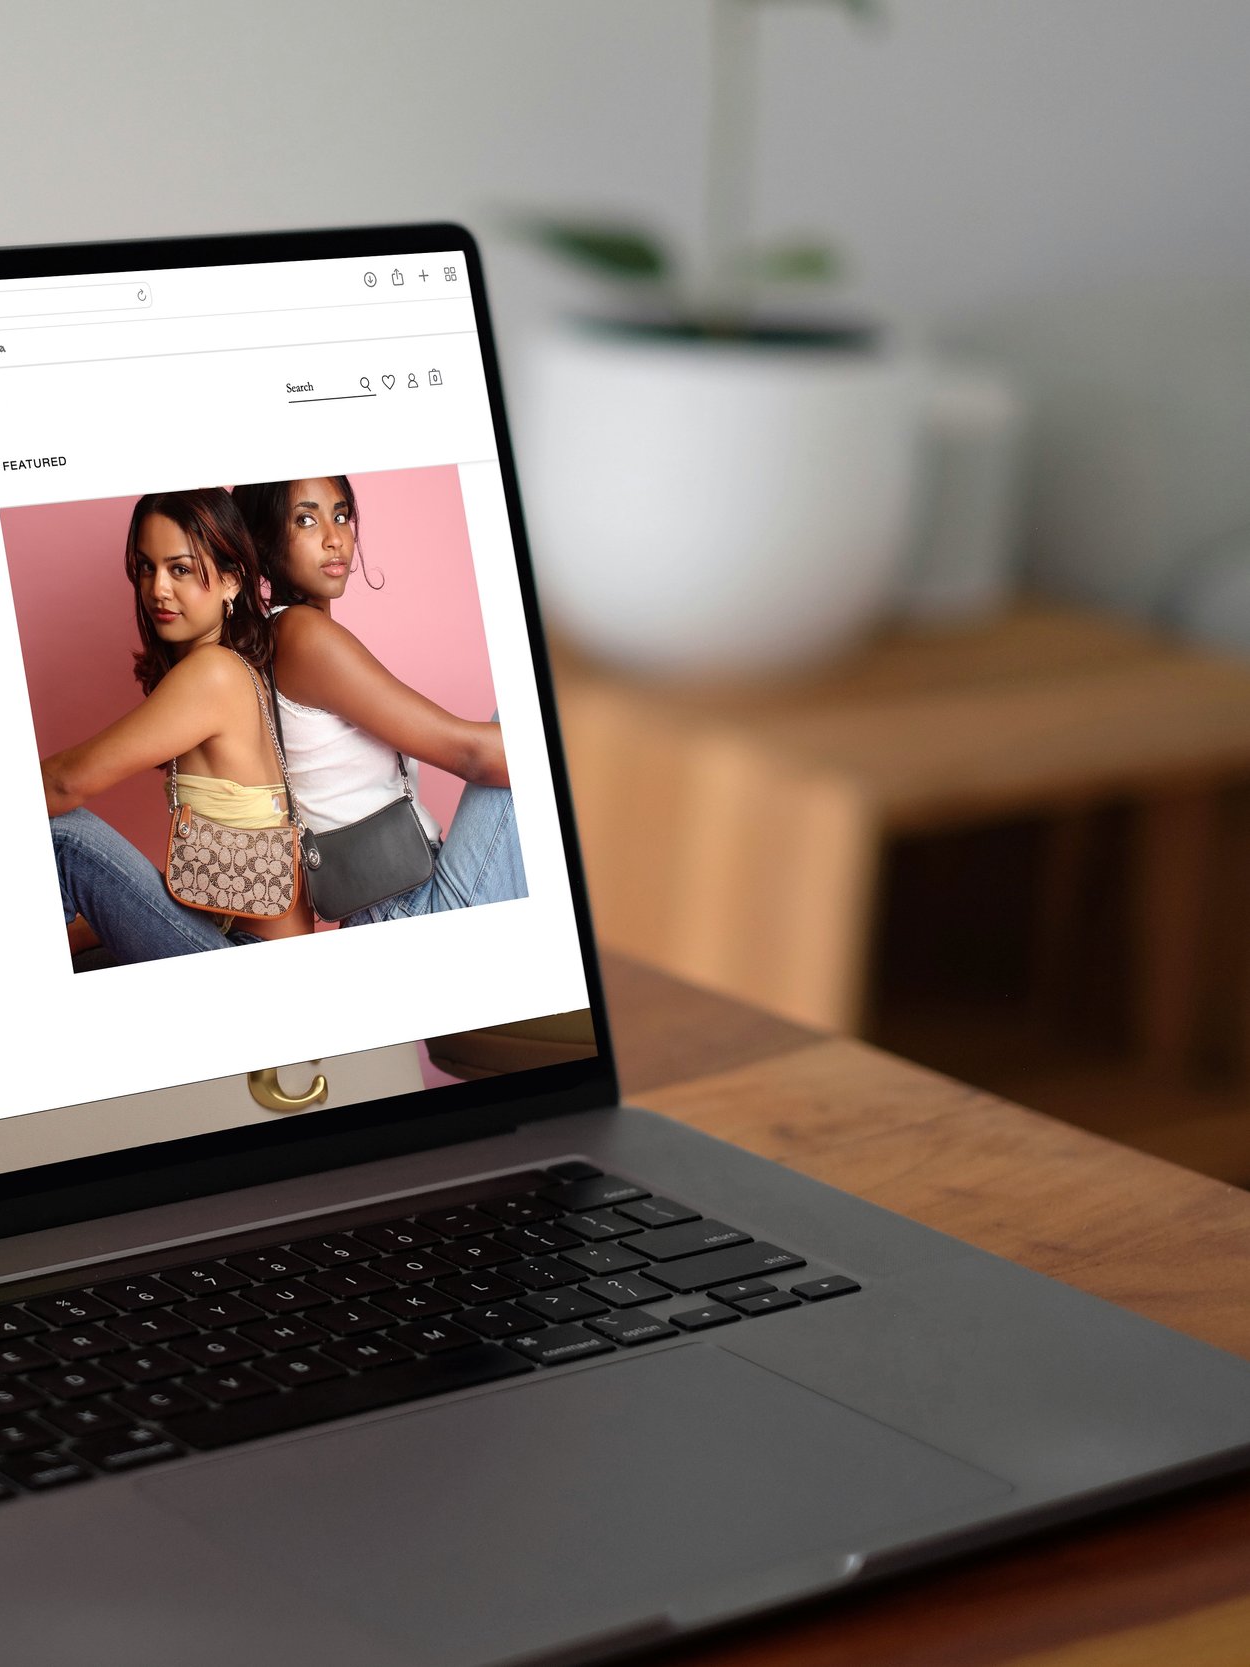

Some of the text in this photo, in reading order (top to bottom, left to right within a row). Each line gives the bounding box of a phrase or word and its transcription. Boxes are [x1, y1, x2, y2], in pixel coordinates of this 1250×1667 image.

[285, 381, 315, 394] Search
[2, 456, 67, 472] FEATURED
[397, 1235, 413, 1243] 0
[704, 1232, 739, 1244] return
[334, 1249, 350, 1258] 9
[468, 1248, 481, 1256] P
[764, 1254, 791, 1266] shift
[270, 1263, 286, 1271] 8
[204, 1277, 217, 1286] 7
[470, 1283, 489, 1291] L
[138, 1292, 154, 1301] 6
[276, 1291, 295, 1300] U
[406, 1297, 426, 1306] K
[69, 1307, 86, 1316] 5
[209, 1306, 226, 1315] Y
[347, 1312, 359, 1322] J
[3, 1322, 18, 1331] 4
[141, 1320, 158, 1330] T
[274, 1327, 295, 1338] H
[422, 1329, 446, 1340] M
[622, 1324, 661, 1338] option
[71, 1336, 92, 1346] R
[206, 1343, 227, 1353] G
[357, 1345, 379, 1355] N
[542, 1338, 601, 1357] command
[1, 1351, 22, 1362] E
[289, 1362, 310, 1373] B
[63, 1374, 86, 1386] D
[218, 1377, 239, 1389] V
[149, 1393, 171, 1406] C
